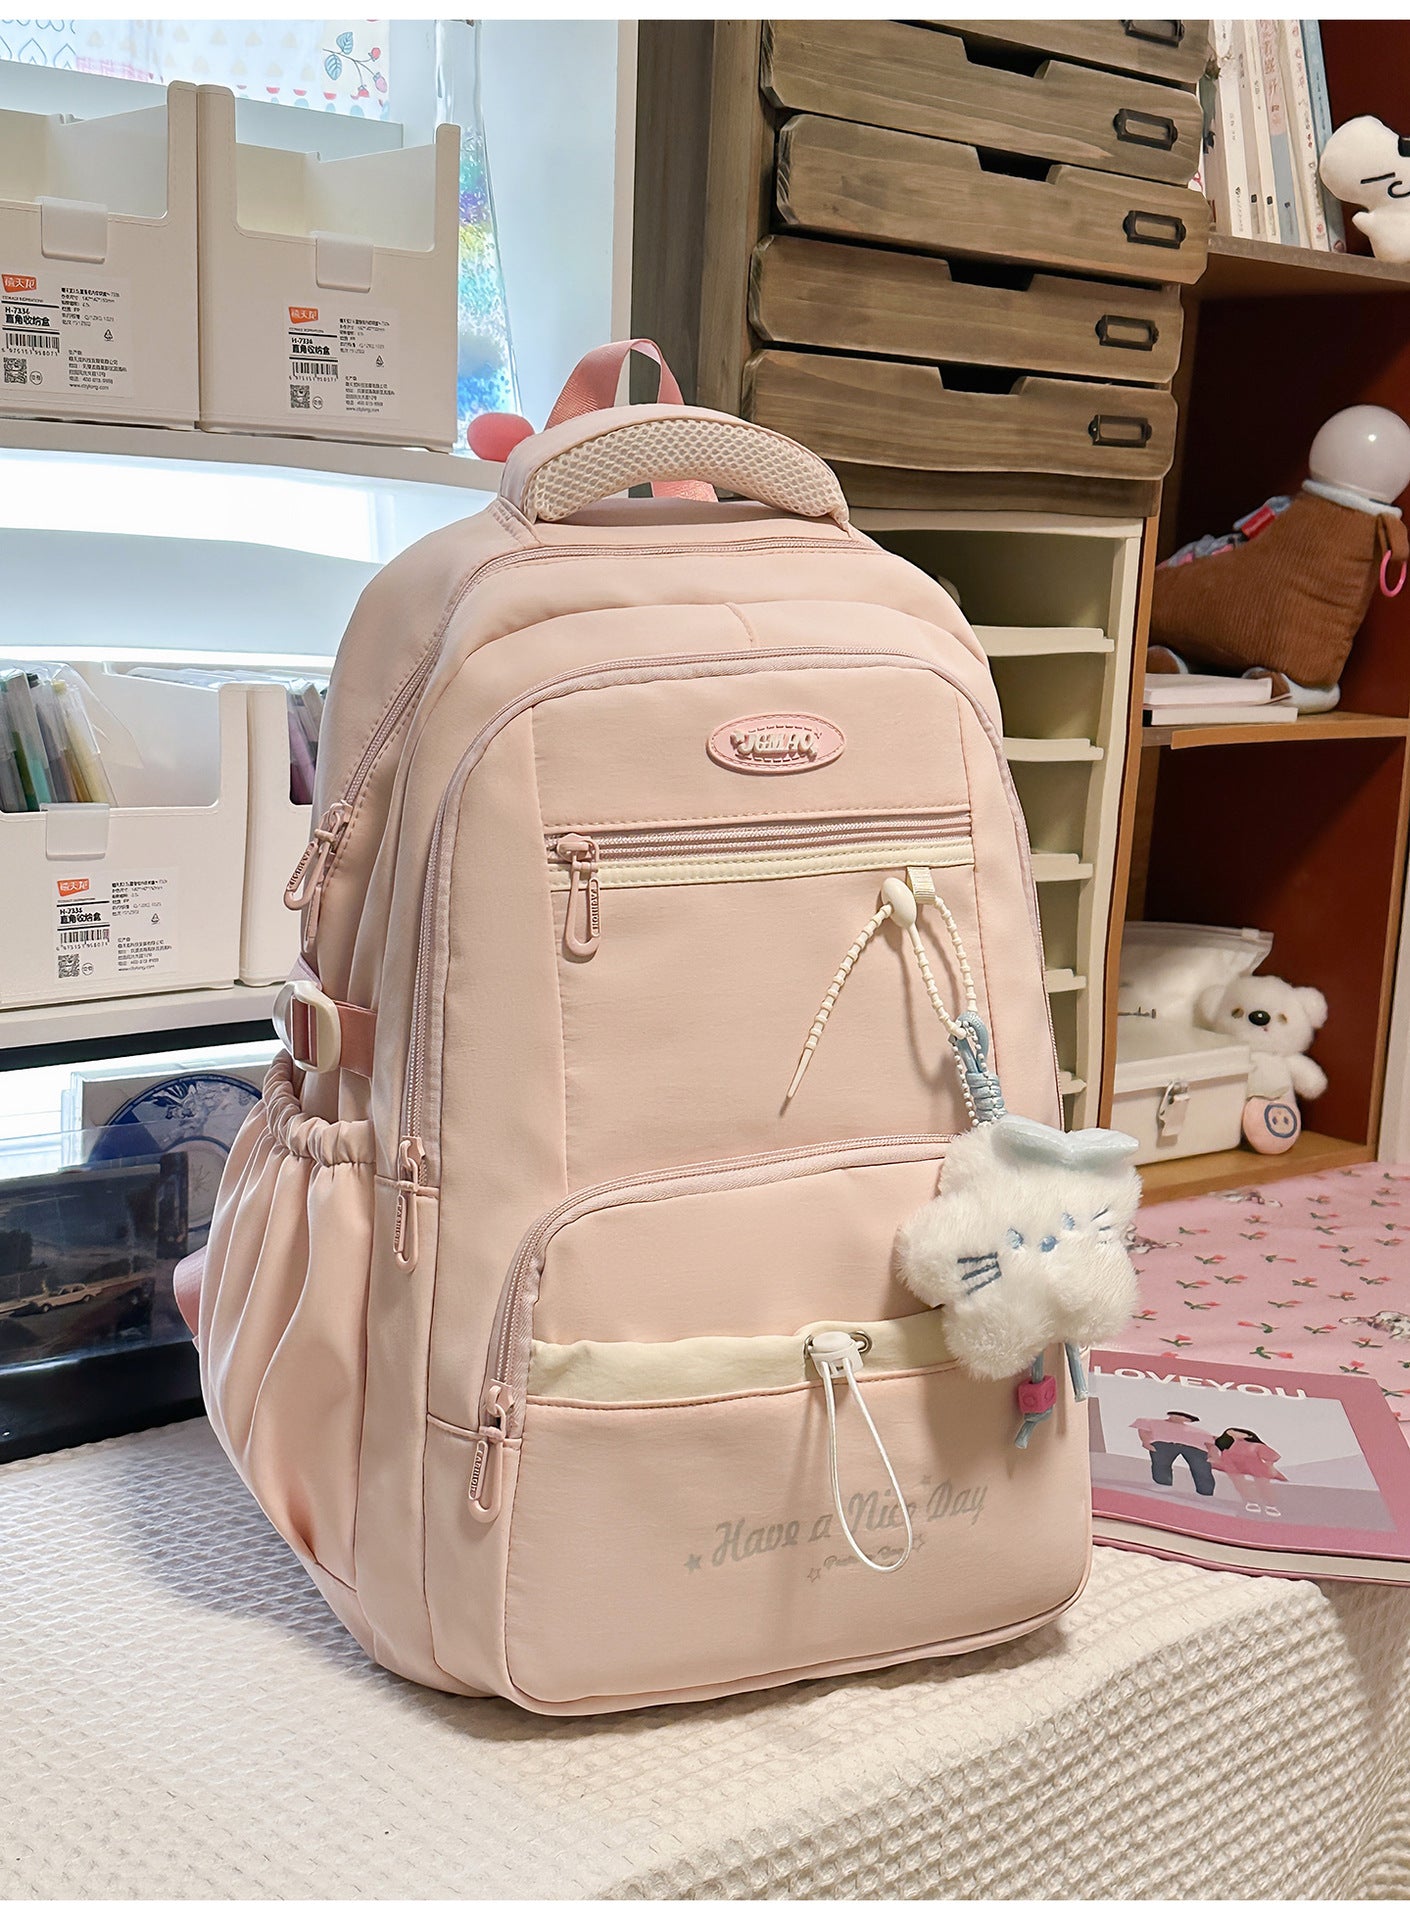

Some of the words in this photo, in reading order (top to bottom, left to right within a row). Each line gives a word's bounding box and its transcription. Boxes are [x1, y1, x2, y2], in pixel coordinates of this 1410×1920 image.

[5, 313, 50, 327] 直角收纳盒
[1094, 1366, 1308, 1400] LOVEYOU
[712, 1517, 800, 1567] Have
[808, 1513, 833, 1543] a
[926, 1478, 988, 1526] Day
